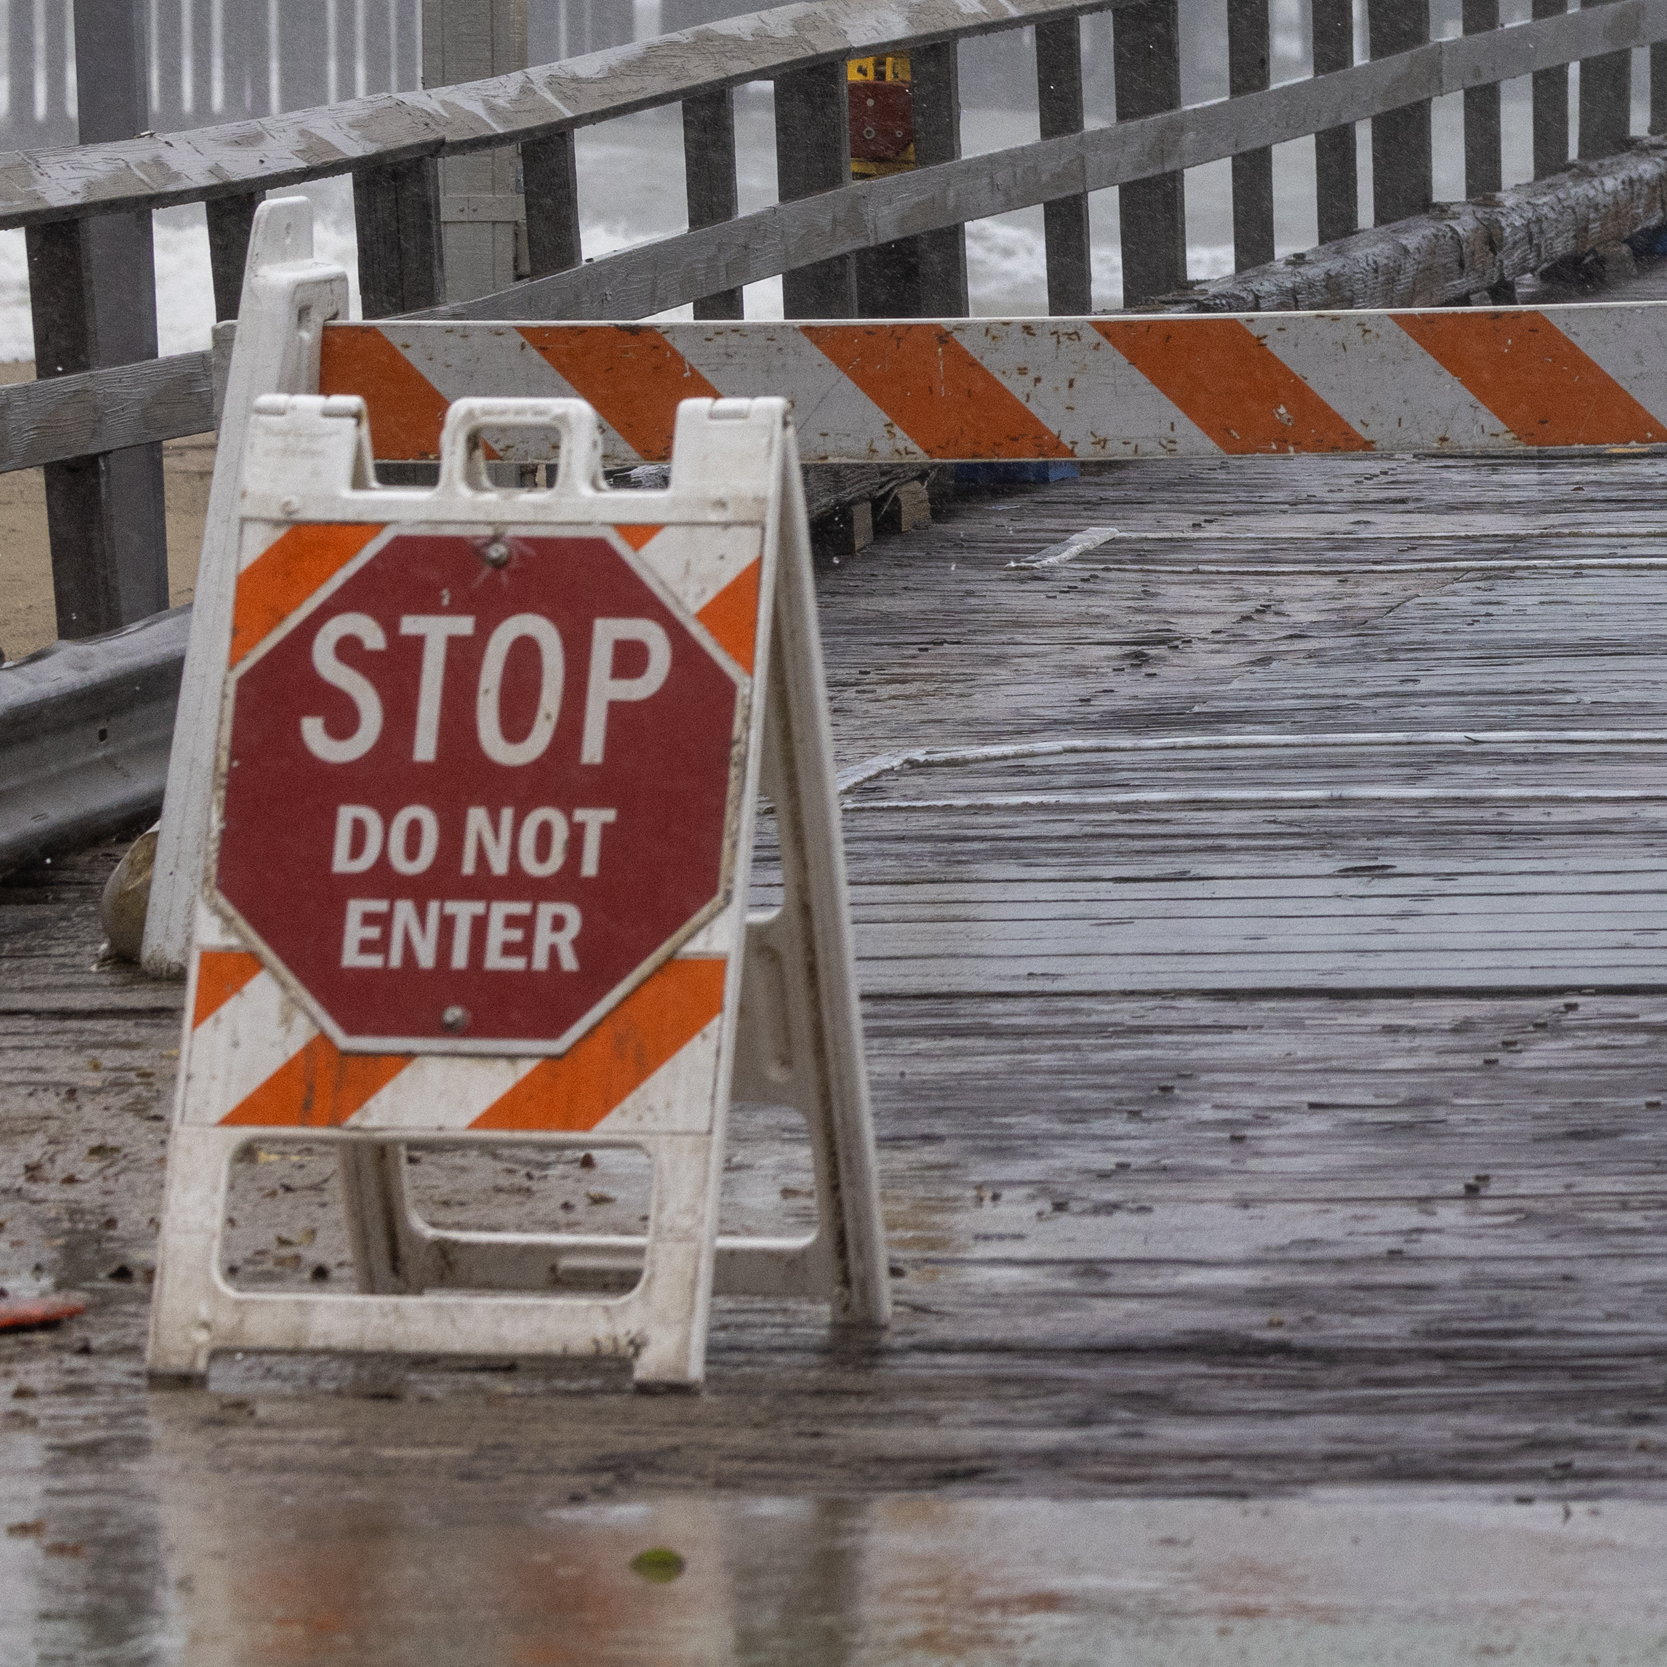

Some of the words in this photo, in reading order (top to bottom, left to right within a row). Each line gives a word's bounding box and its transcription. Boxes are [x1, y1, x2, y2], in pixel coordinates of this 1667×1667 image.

[299, 611, 673, 767] STOP
[331, 804, 439, 876] DO
[461, 806, 617, 879] NOT
[340, 898, 582, 972] ENTER
